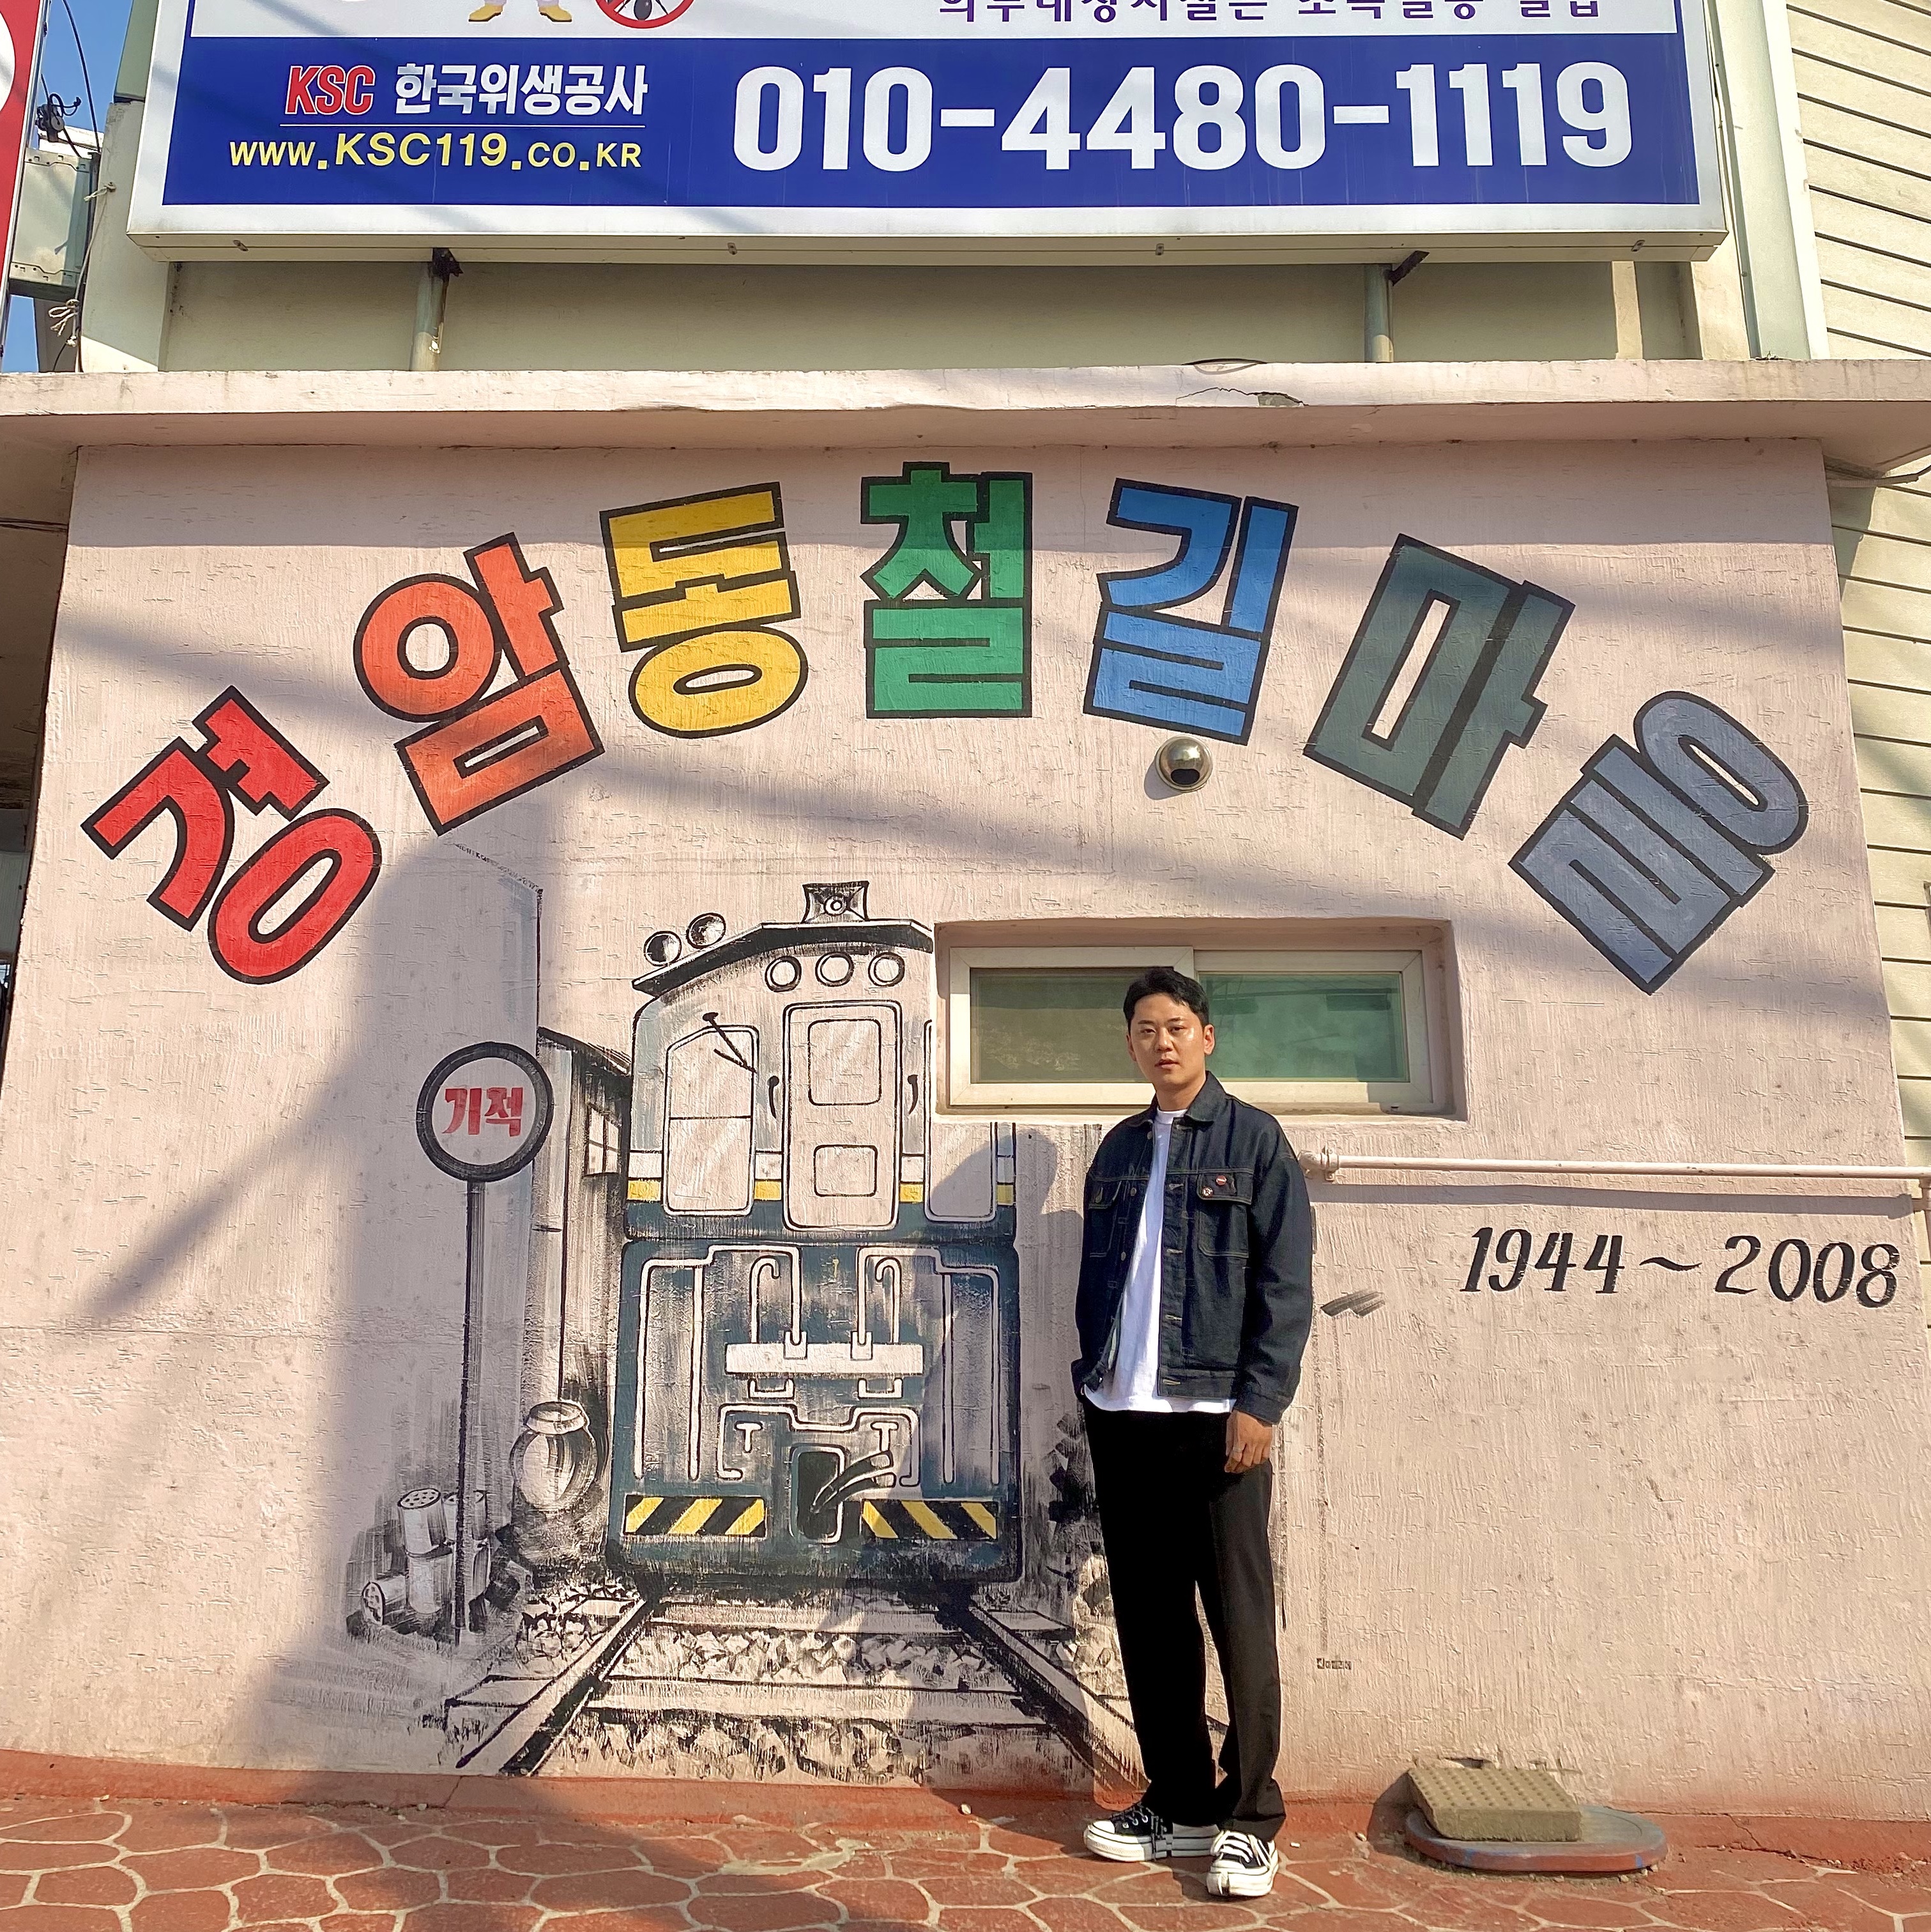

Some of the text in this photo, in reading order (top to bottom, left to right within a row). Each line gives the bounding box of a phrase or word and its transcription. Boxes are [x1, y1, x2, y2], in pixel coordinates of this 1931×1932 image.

[285, 63, 648, 116] KSC 한국위생공사
[733, 61, 1633, 171] 010-4480-1119
[441, 1087, 524, 1137] 기적
